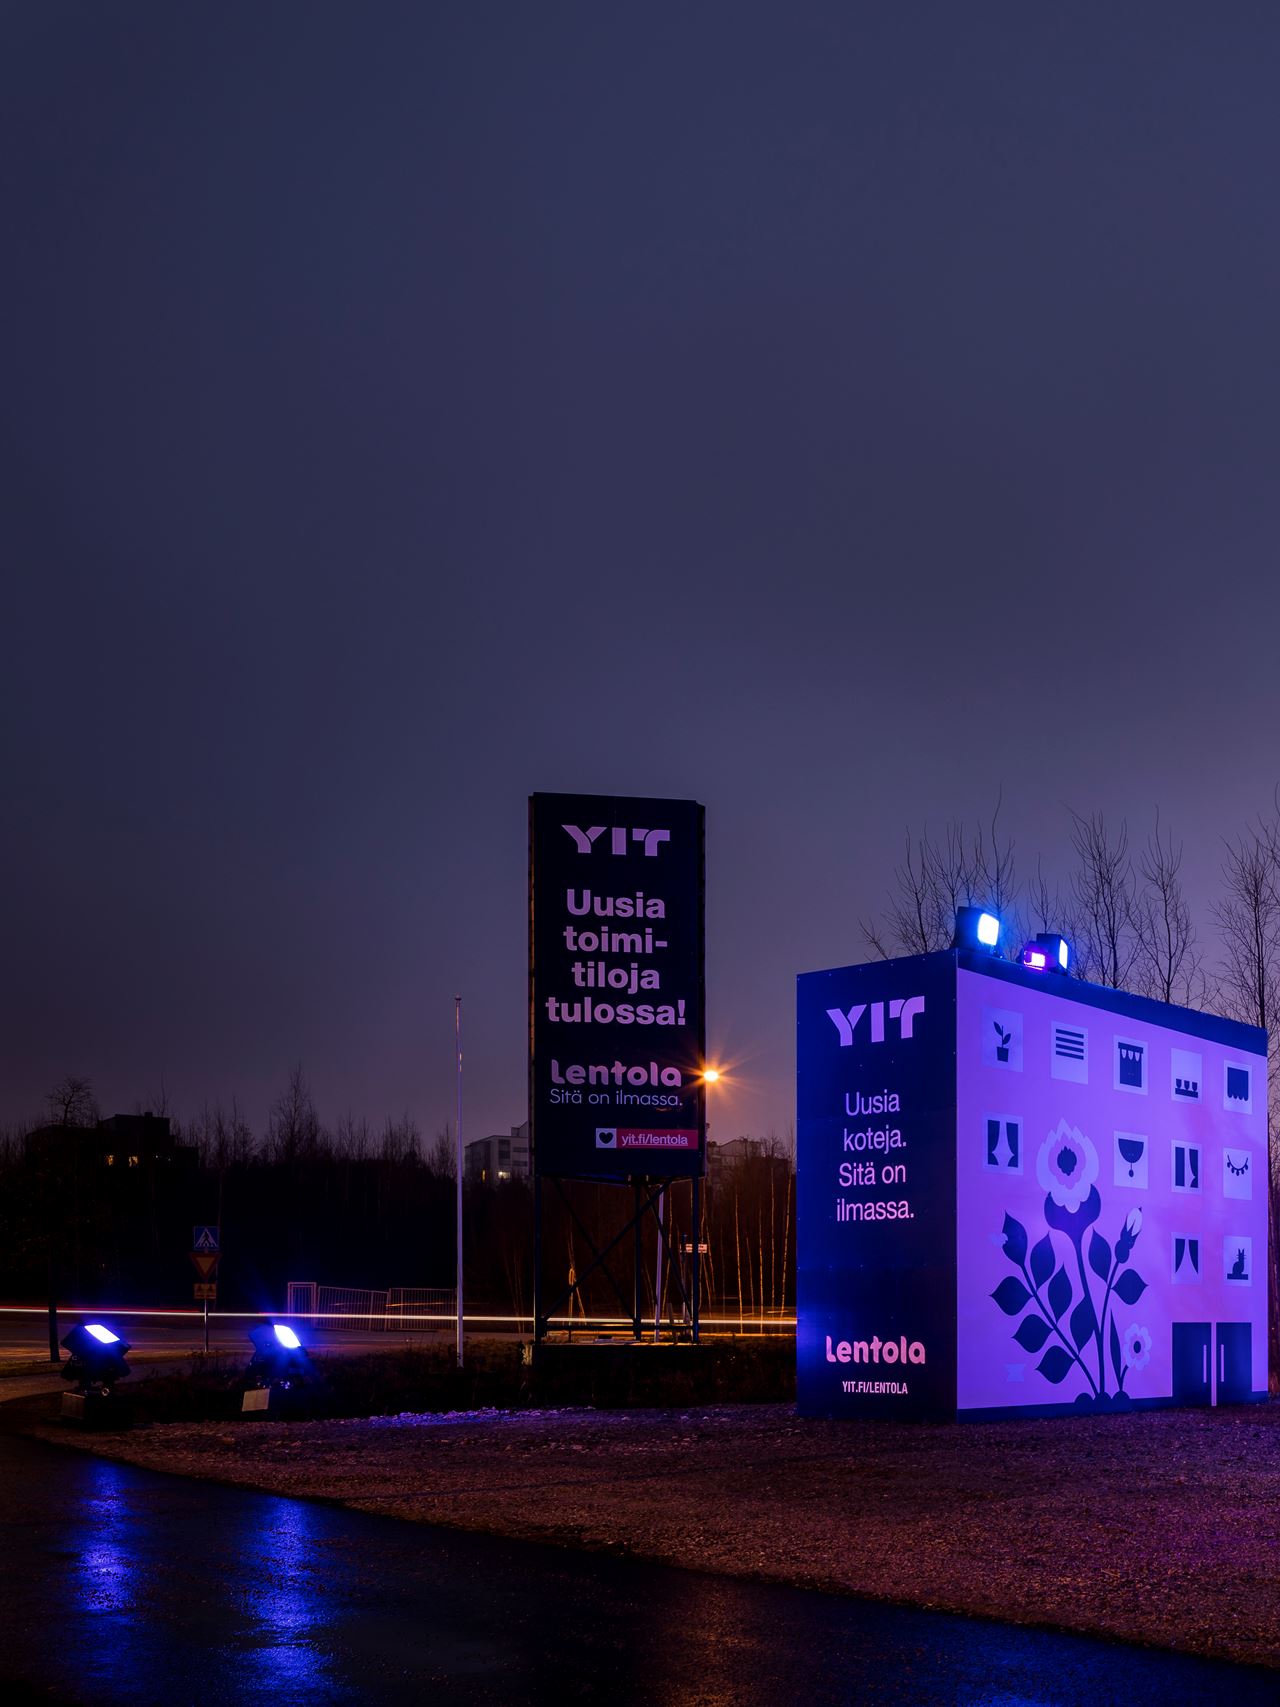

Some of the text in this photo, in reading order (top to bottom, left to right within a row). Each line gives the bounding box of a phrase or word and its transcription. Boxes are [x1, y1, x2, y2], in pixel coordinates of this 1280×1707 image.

[561, 824, 670, 857] YIT
[566, 888, 665, 918] Uusia
[563, 925, 668, 954] toimi-
[571, 961, 660, 994] tiloja
[545, 996, 686, 1026] tulossa!
[826, 995, 925, 1047] YIT
[551, 1059, 682, 1088] Lentola
[549, 1088, 683, 1107] Sitä on ilmassa.
[845, 1088, 901, 1116] Uusia
[621, 1133, 688, 1147] yit.fi/lentola
[844, 1124, 907, 1155] koteja.
[838, 1161, 906, 1187] Sitä on
[836, 1198, 915, 1222] ilmassa.
[825, 1335, 926, 1365] Lentola
[841, 1380, 908, 1395] YIT.FI/LENTOLA
